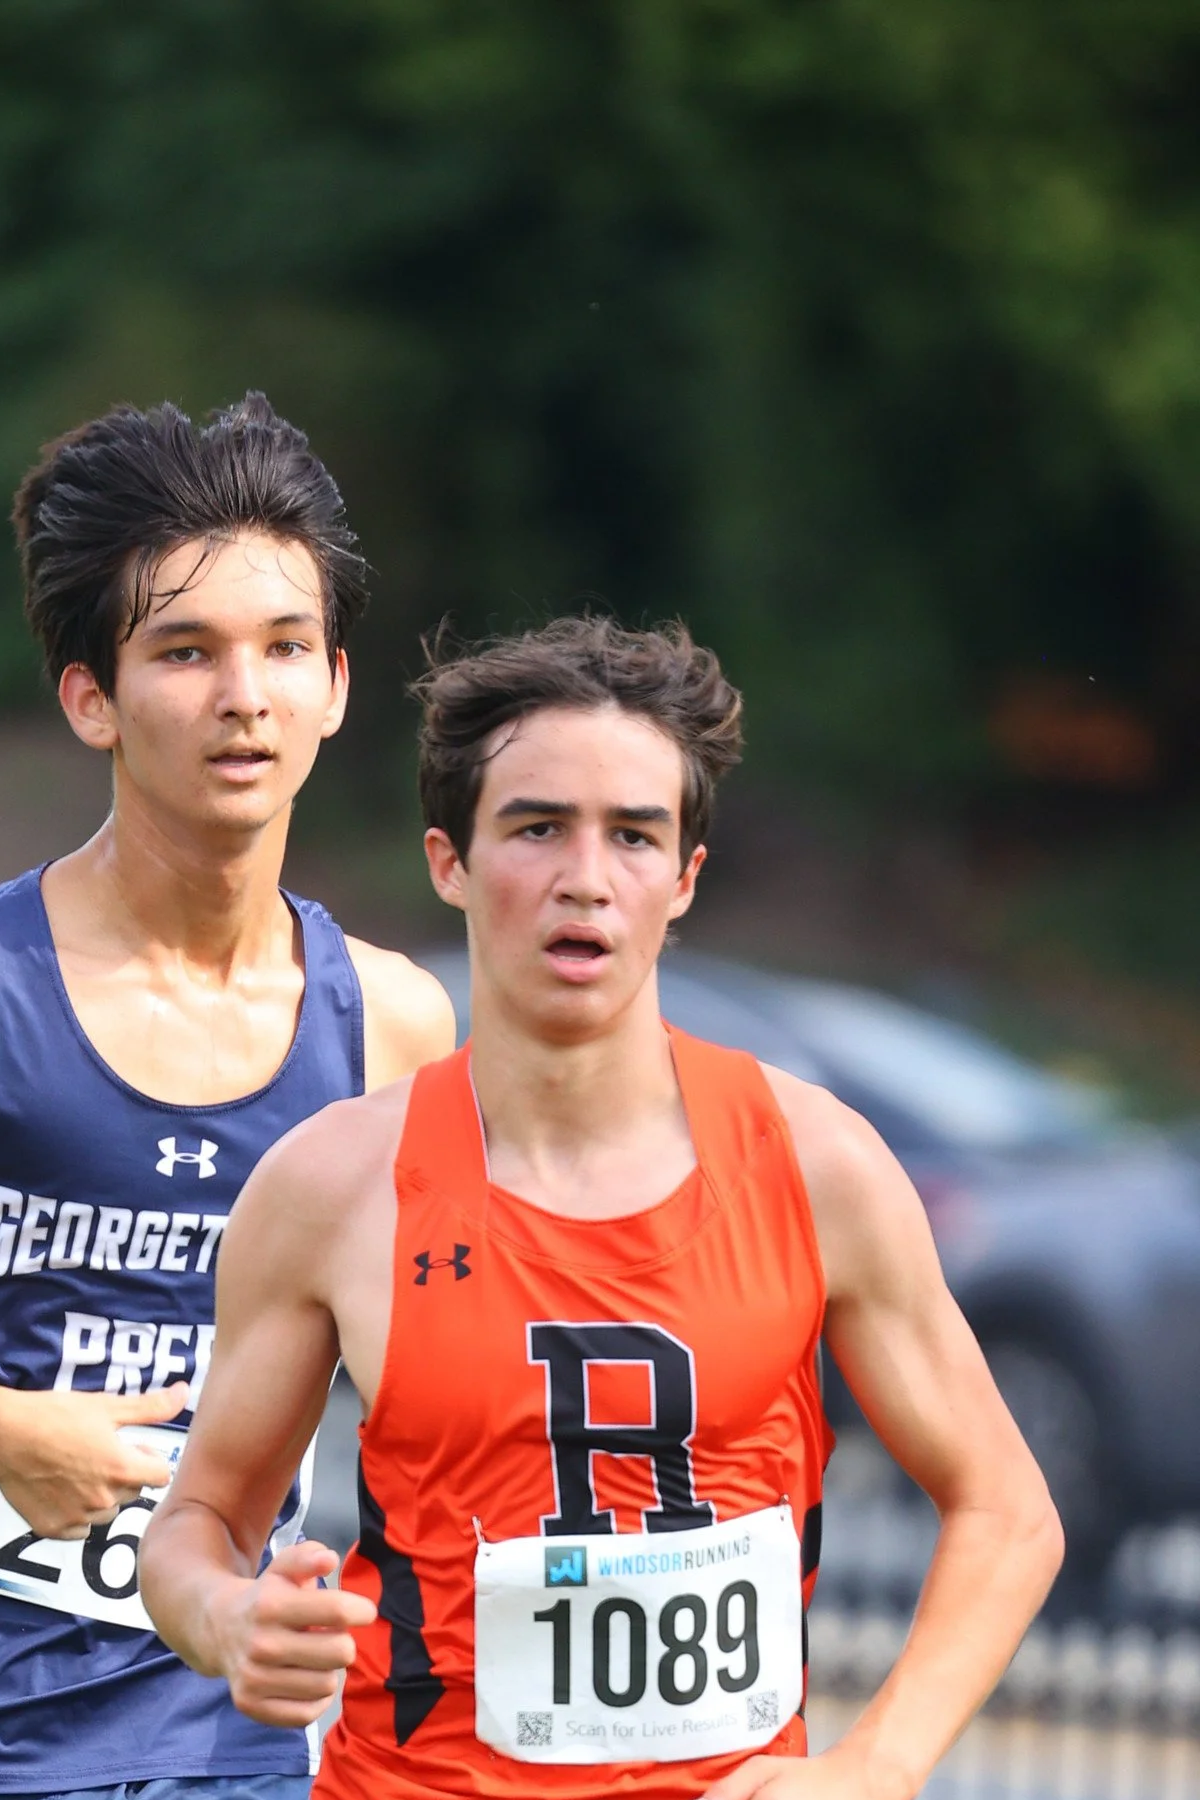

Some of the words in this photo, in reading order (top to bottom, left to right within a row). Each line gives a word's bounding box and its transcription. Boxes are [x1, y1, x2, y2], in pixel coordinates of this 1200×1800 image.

[525, 1321, 719, 1537] R
[533, 1579, 761, 1708] 1089
[565, 1720, 607, 1738] Scan
[612, 1721, 636, 1738] for
[642, 1722, 677, 1738] Live
[681, 1712, 739, 1735] Results
